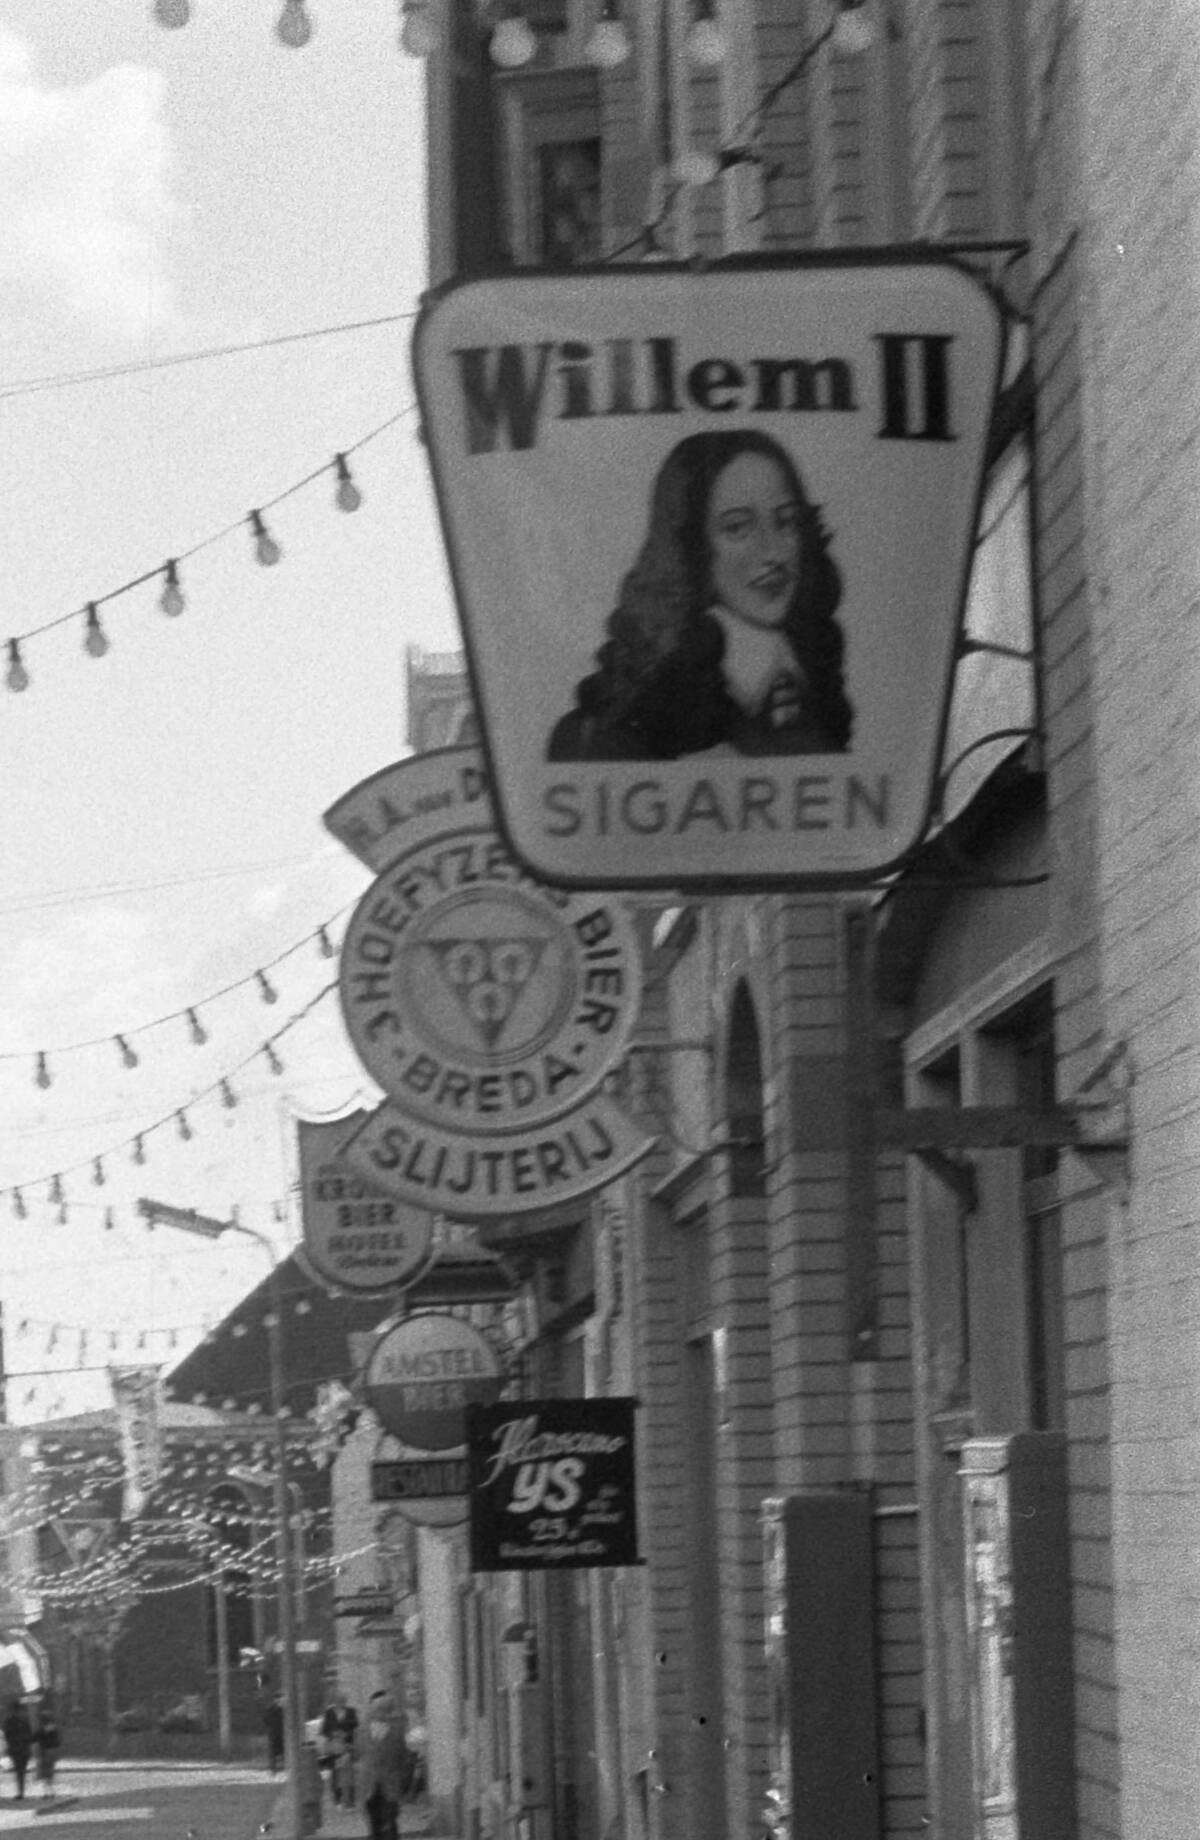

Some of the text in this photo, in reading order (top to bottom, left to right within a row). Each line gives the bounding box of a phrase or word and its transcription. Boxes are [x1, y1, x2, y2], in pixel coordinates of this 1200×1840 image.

[454, 332, 957, 456] Willem II
[542, 774, 890, 839] SIGAREN
[575, 909, 624, 1036] BIER
[401, 1052, 582, 1113] BREDA
[371, 1116, 616, 1196] SLIJTERIJ
[383, 1349, 487, 1377] AMSTEL
